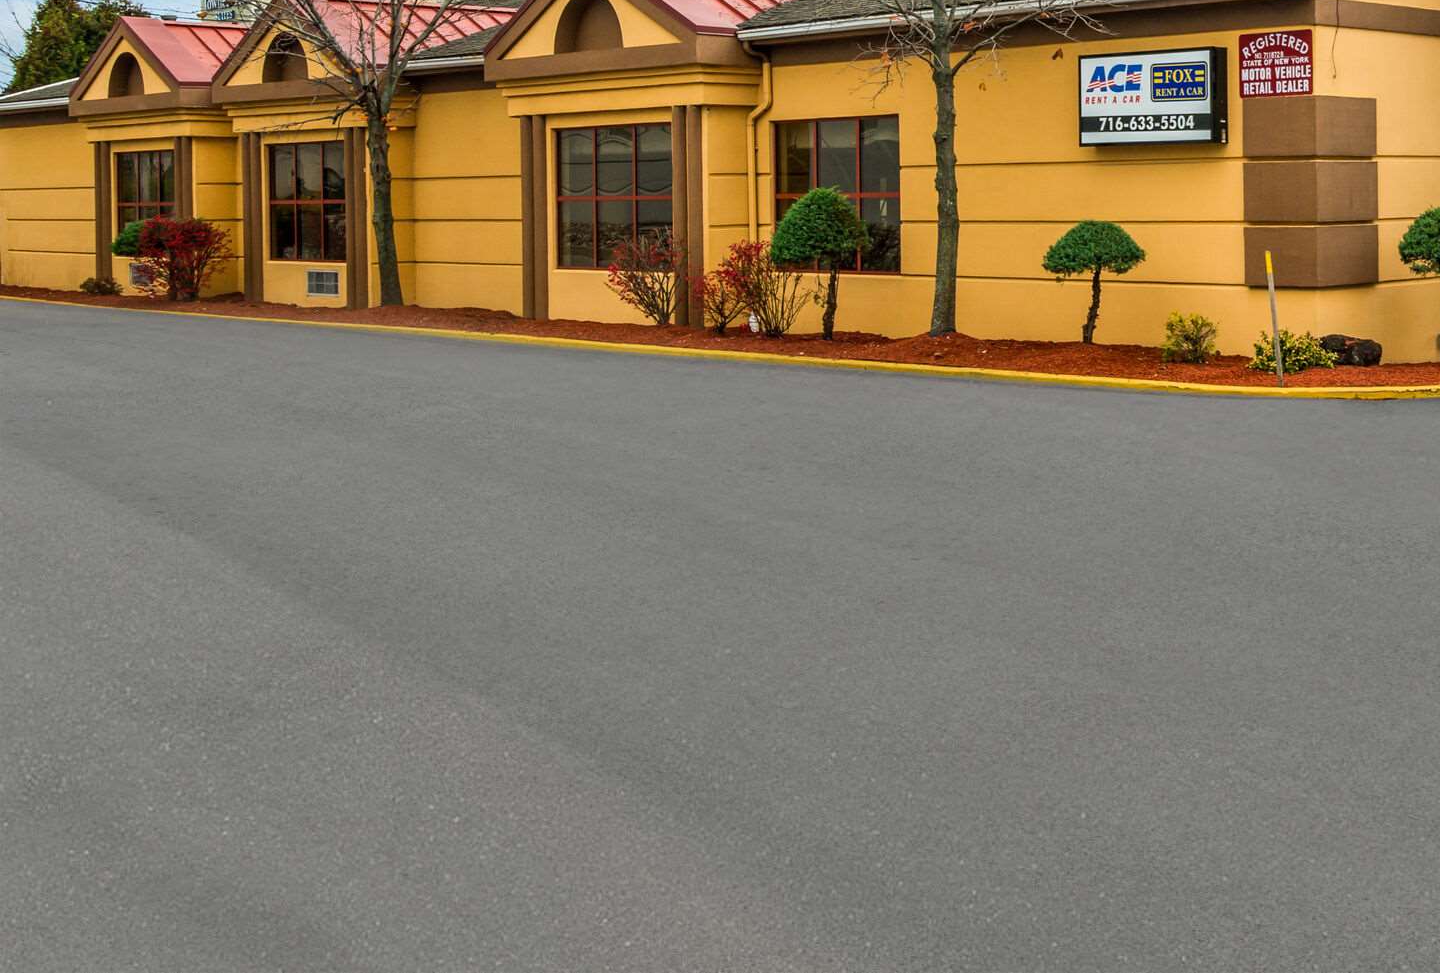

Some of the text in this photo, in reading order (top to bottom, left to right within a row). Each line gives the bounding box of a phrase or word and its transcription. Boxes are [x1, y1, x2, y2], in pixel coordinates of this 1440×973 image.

[1242, 33, 1309, 59] REGISTERED
[1242, 56, 1310, 67] STATE OF NEW YORK
[1086, 63, 1143, 93] ACE
[1164, 68, 1193, 84] FOX
[1241, 65, 1312, 81] MOTOR VEHICLE
[1155, 86, 1204, 97] RENT A CAR
[1243, 79, 1310, 95] RETAIL DEALER
[1085, 94, 1141, 105] RENT A CAR
[1099, 115, 1195, 131] 716-633-5504
